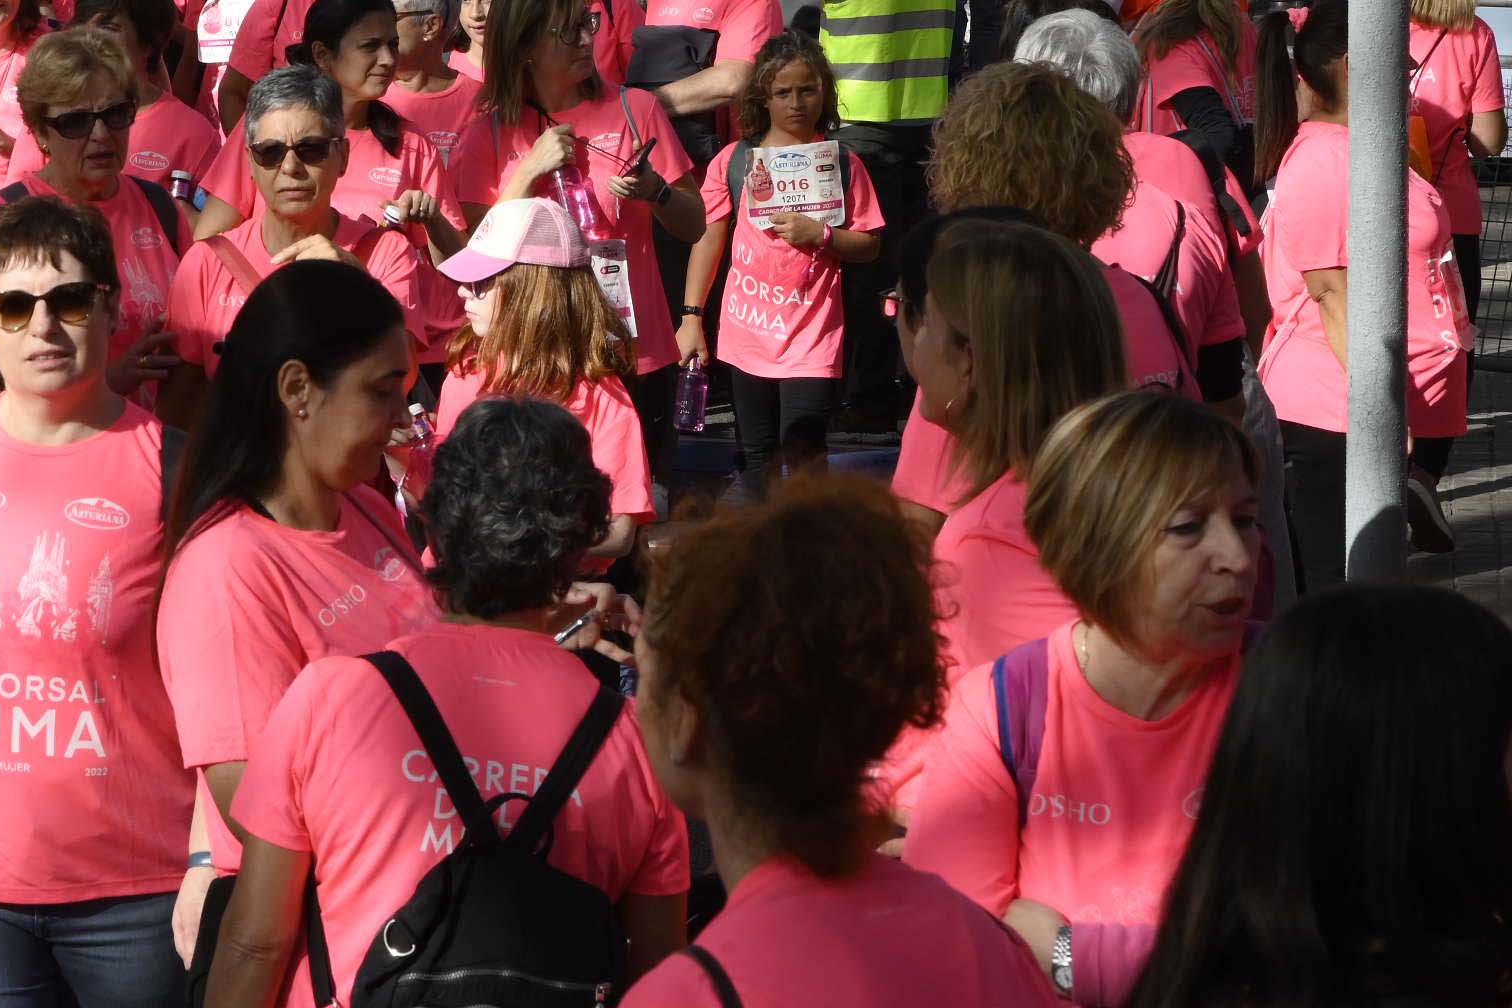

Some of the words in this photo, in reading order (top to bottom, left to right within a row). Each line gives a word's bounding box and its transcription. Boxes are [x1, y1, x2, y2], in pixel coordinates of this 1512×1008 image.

[776, 178, 810, 192] 016
[782, 194, 807, 204] 12071
[727, 293, 787, 333] SUMA
[69, 504, 126, 525] ASTURIANA
[84, 767, 109, 777] 2022
